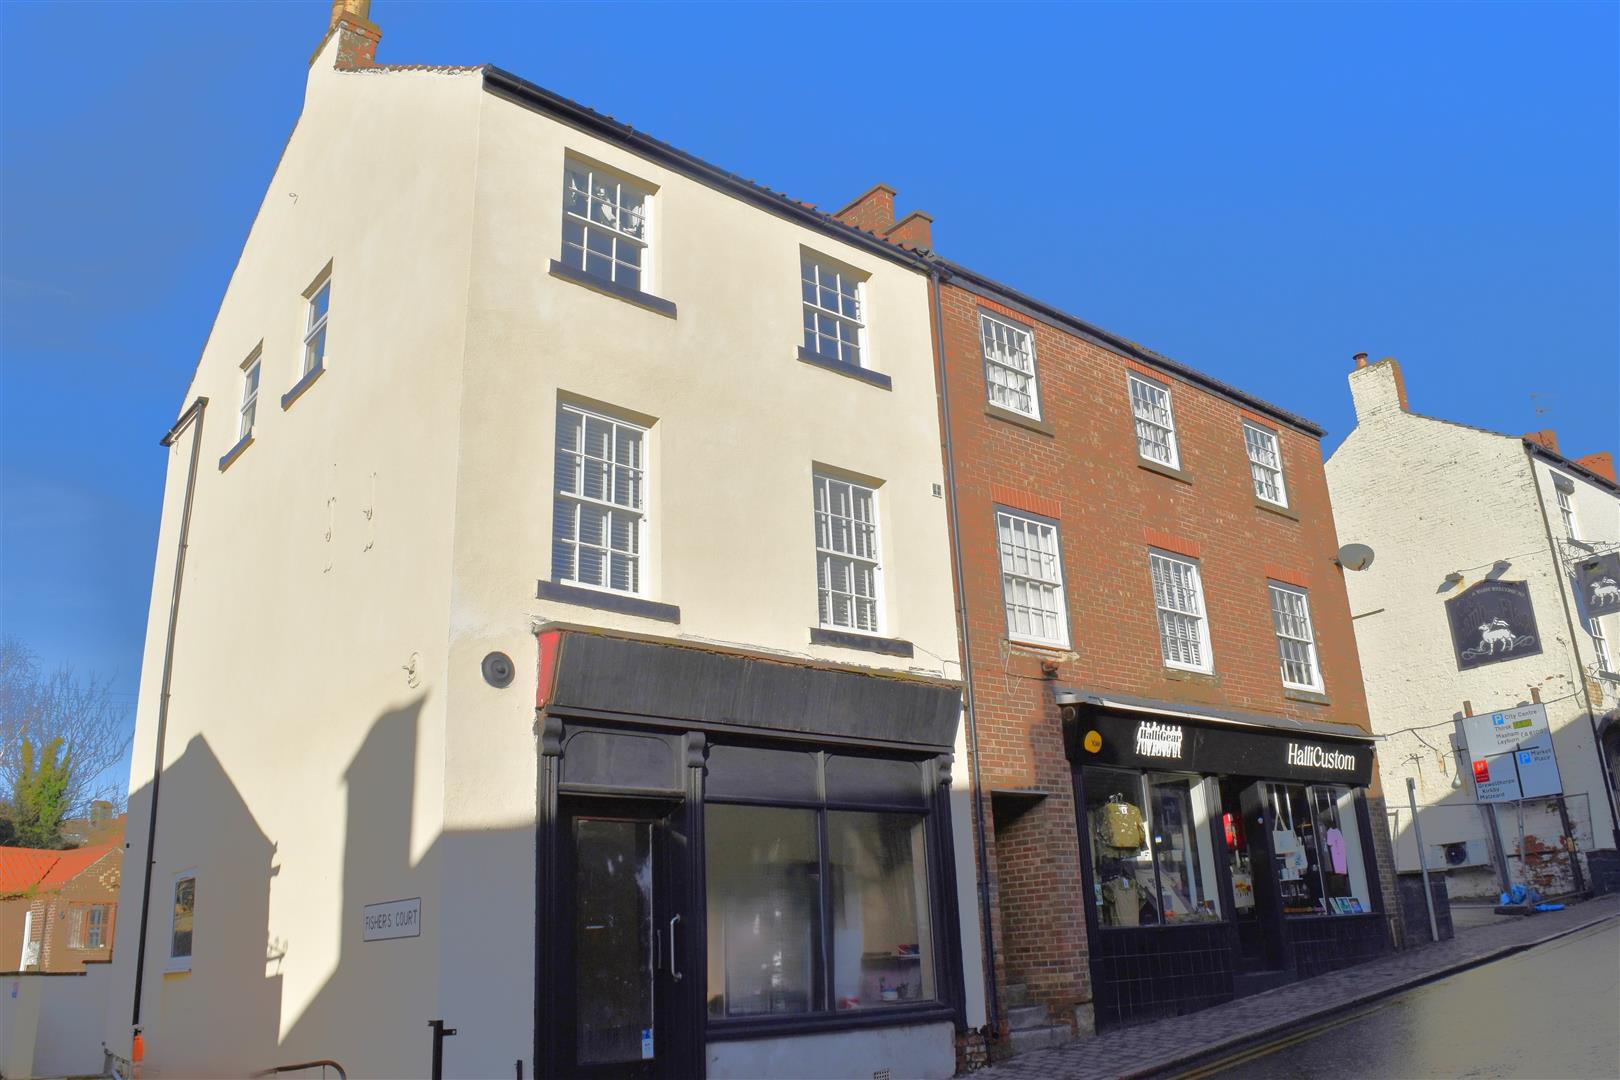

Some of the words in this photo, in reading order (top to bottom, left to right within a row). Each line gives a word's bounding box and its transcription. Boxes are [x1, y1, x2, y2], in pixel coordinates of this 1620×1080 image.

[1518, 710, 1537, 718] Centre
[1140, 729, 1182, 743] HalliGear
[1288, 743, 1355, 771] HalliCustom
[396, 909, 418, 927] COURT
